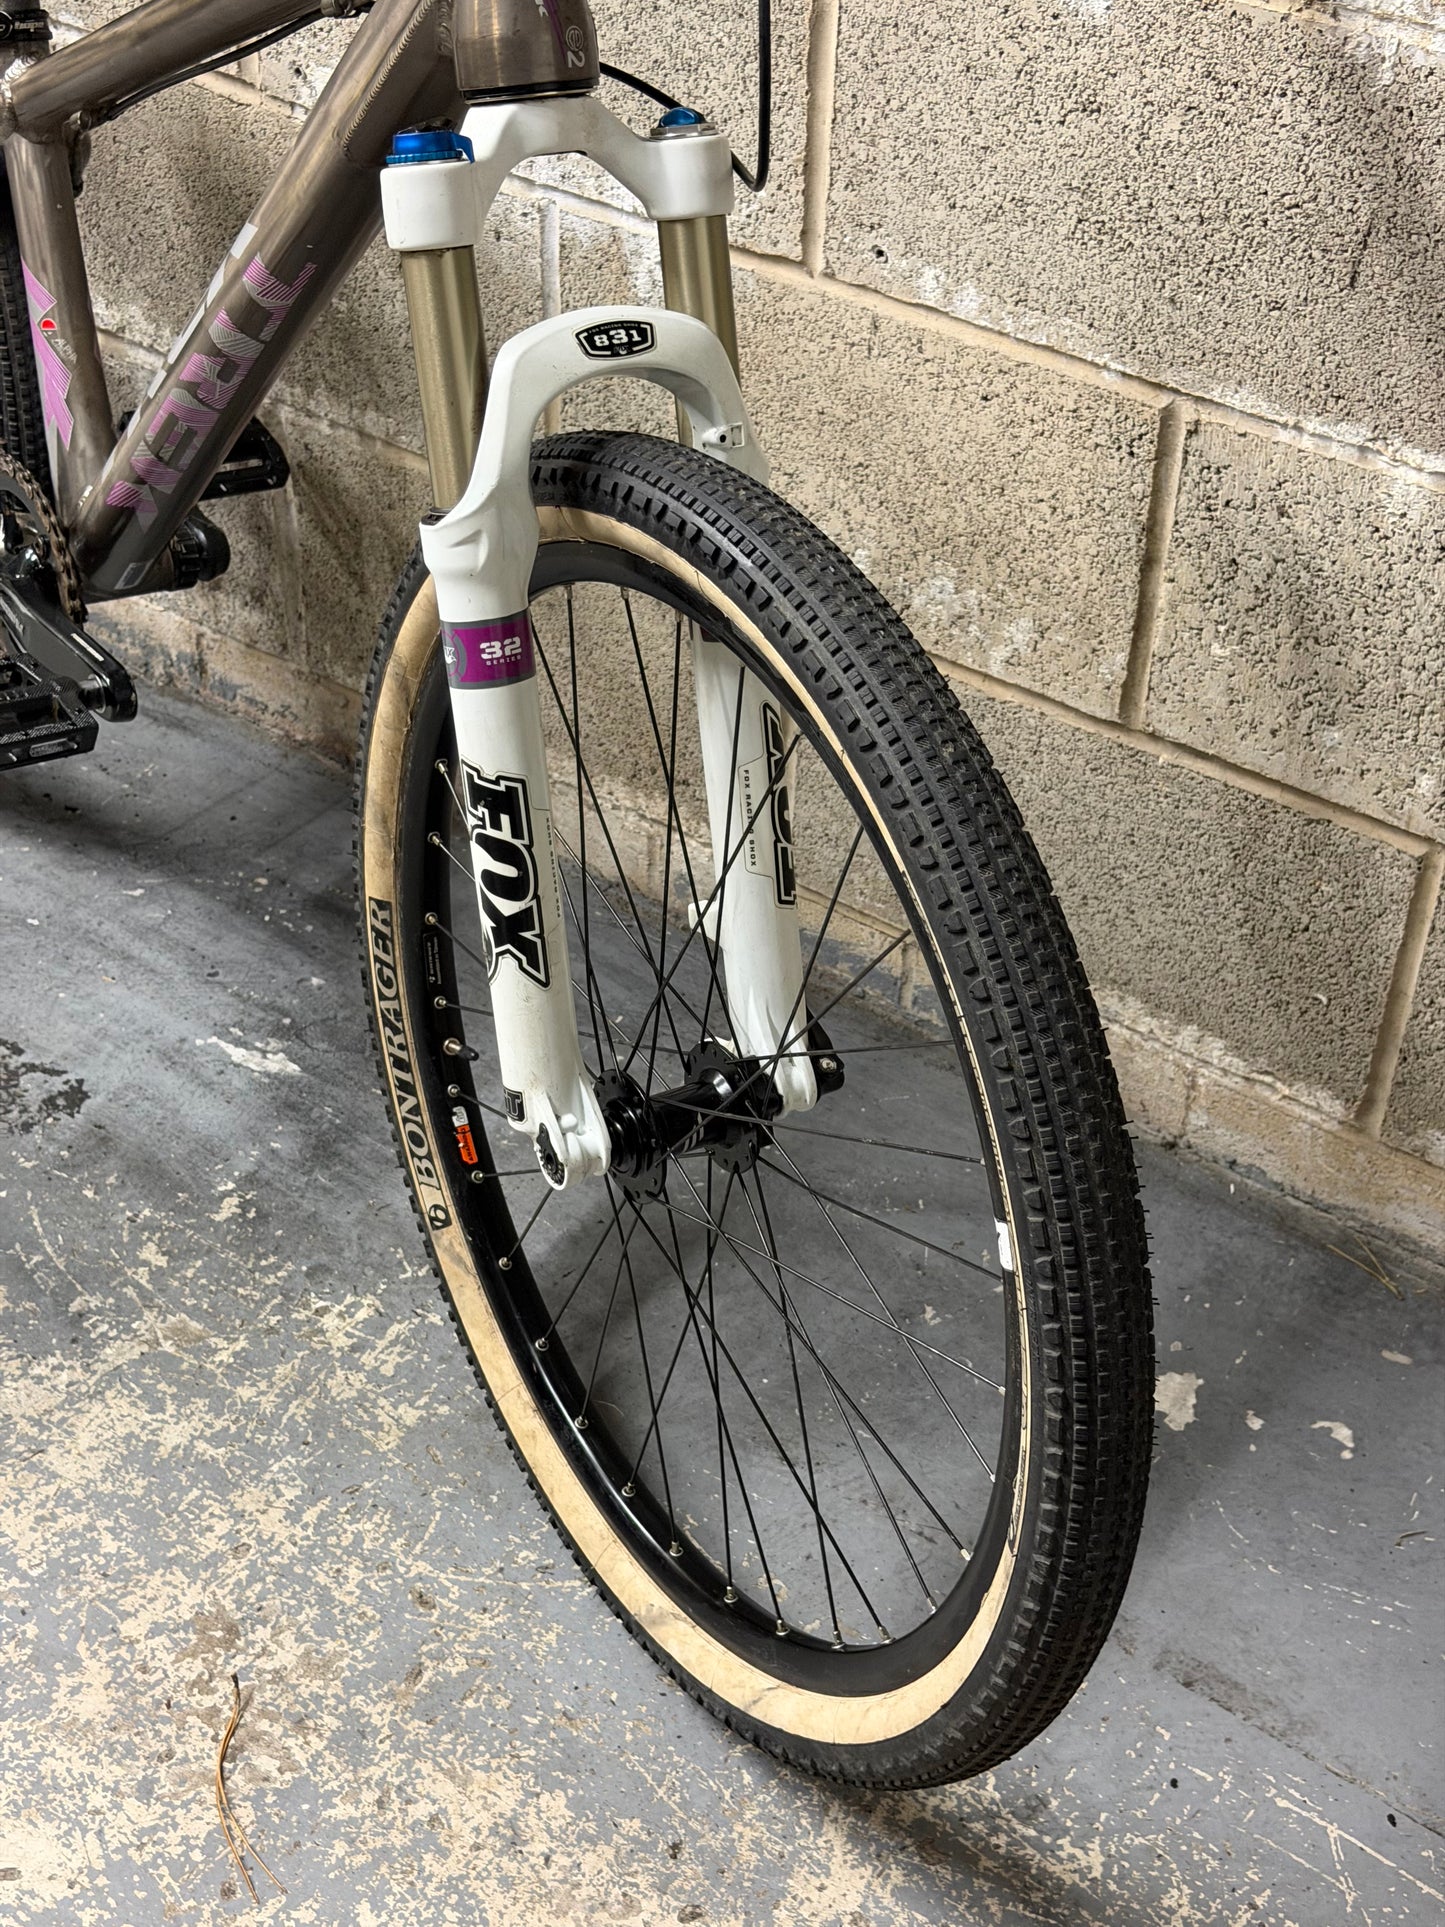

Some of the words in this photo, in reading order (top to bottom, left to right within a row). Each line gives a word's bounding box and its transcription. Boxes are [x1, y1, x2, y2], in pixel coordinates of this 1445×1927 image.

[594, 329, 642, 347] 831
[105, 250, 318, 534] TREK
[479, 636, 522, 660] 32
[486, 655, 522, 666] SERIES
[743, 769, 751, 789] FOX
[745, 793, 755, 834] RACIG
[749, 839, 757, 867] SHOX
[462, 760, 550, 986] FOX
[370, 899, 441, 1190] BONTRAGER
